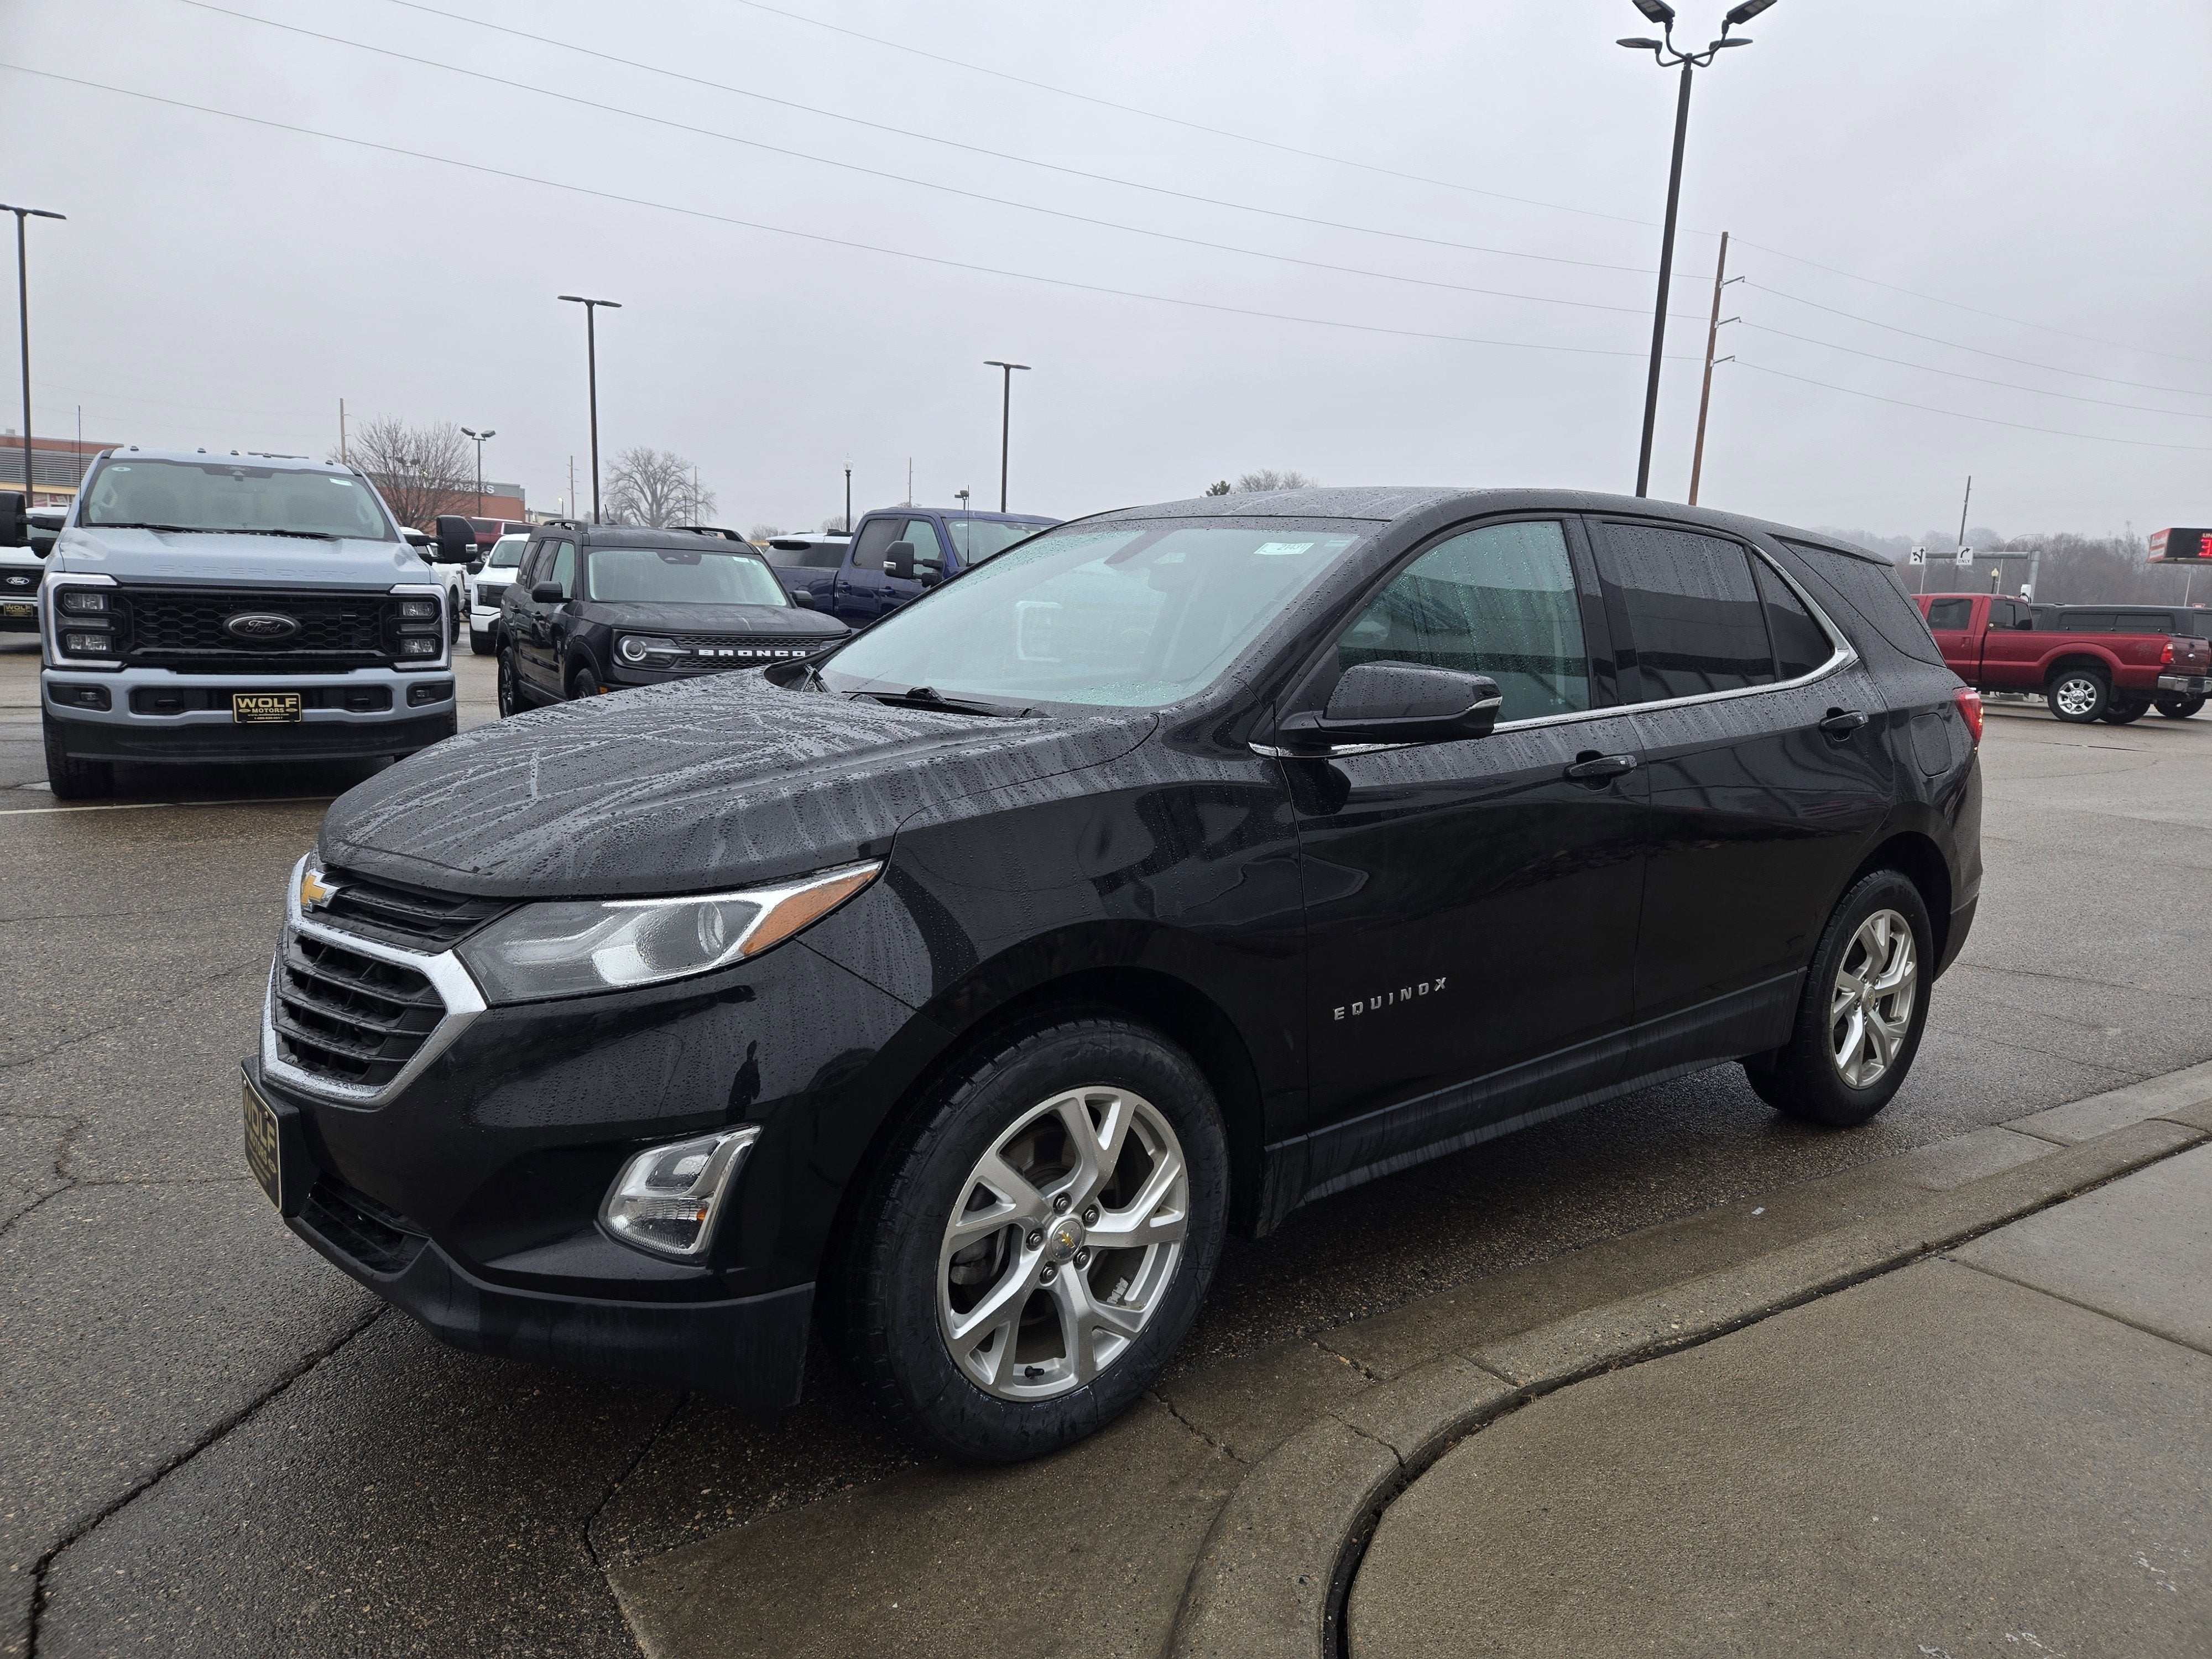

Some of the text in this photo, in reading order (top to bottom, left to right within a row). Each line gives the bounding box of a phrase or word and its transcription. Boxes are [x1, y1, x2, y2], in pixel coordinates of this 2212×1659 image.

[244, 620, 280, 633] Ford
[237, 698, 297, 707] WOLF
[1334, 977, 1447, 1021] EQUINOX
[243, 1086, 275, 1152] WOLF
